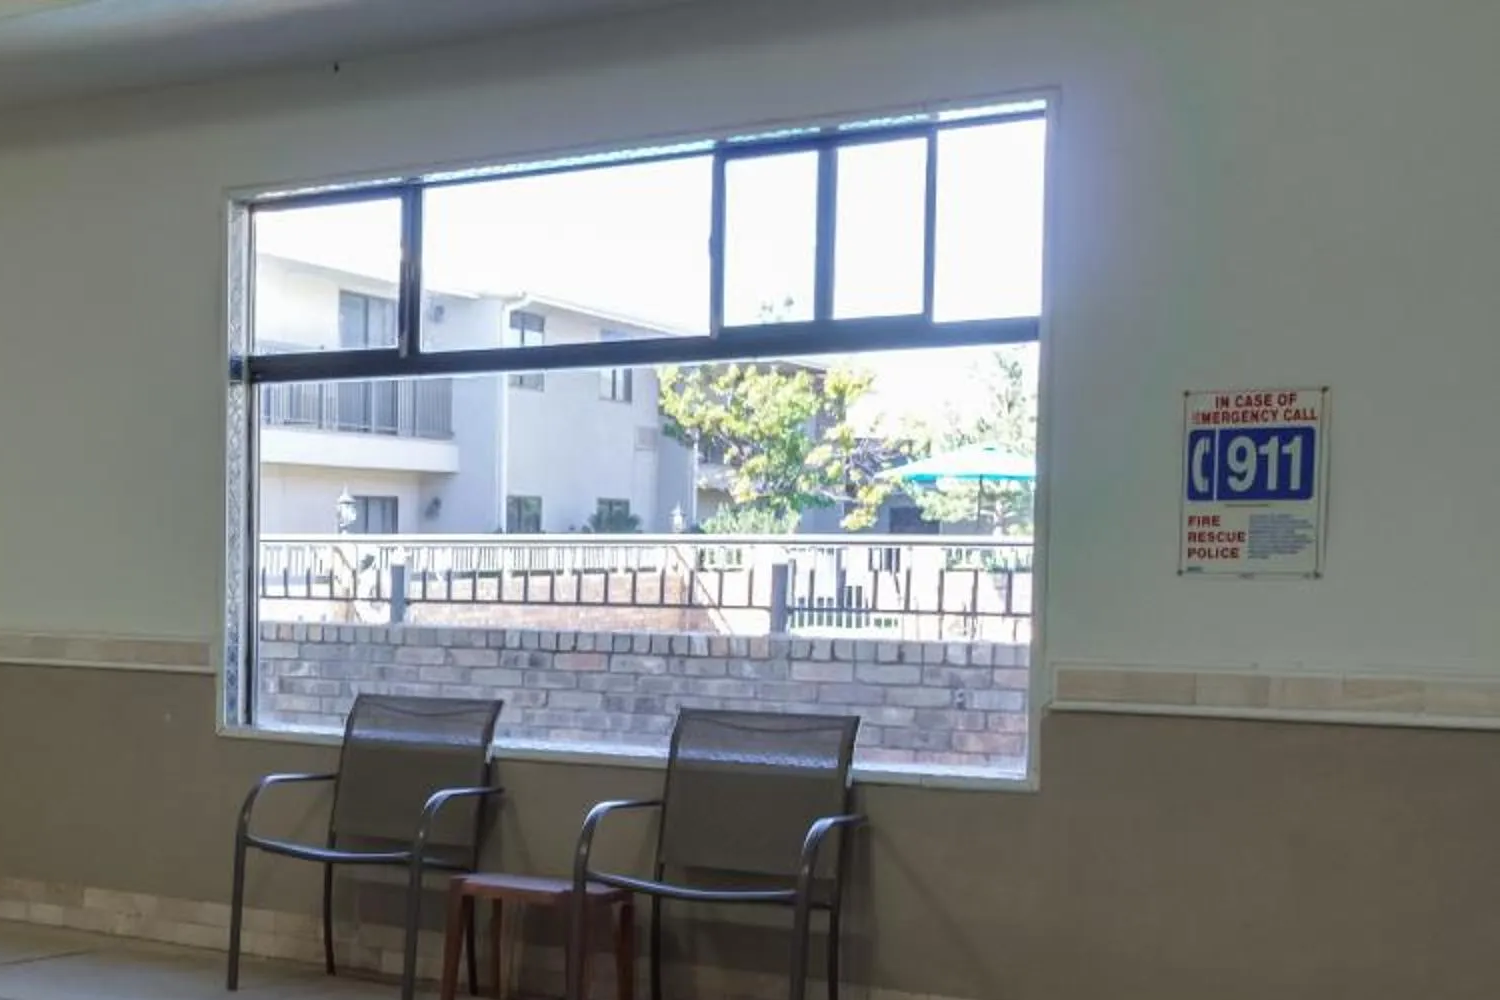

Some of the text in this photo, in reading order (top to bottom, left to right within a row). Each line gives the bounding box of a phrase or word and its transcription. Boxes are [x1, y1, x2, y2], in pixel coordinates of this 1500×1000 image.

[1215, 392, 1298, 409] IN CASE OF
[1192, 407, 1317, 424] EMERGENCY CALL
[1227, 436, 1303, 492] 911
[1188, 515, 1221, 527] FIRE
[1188, 531, 1246, 542] RESCUE
[1188, 547, 1240, 559] POLICE
